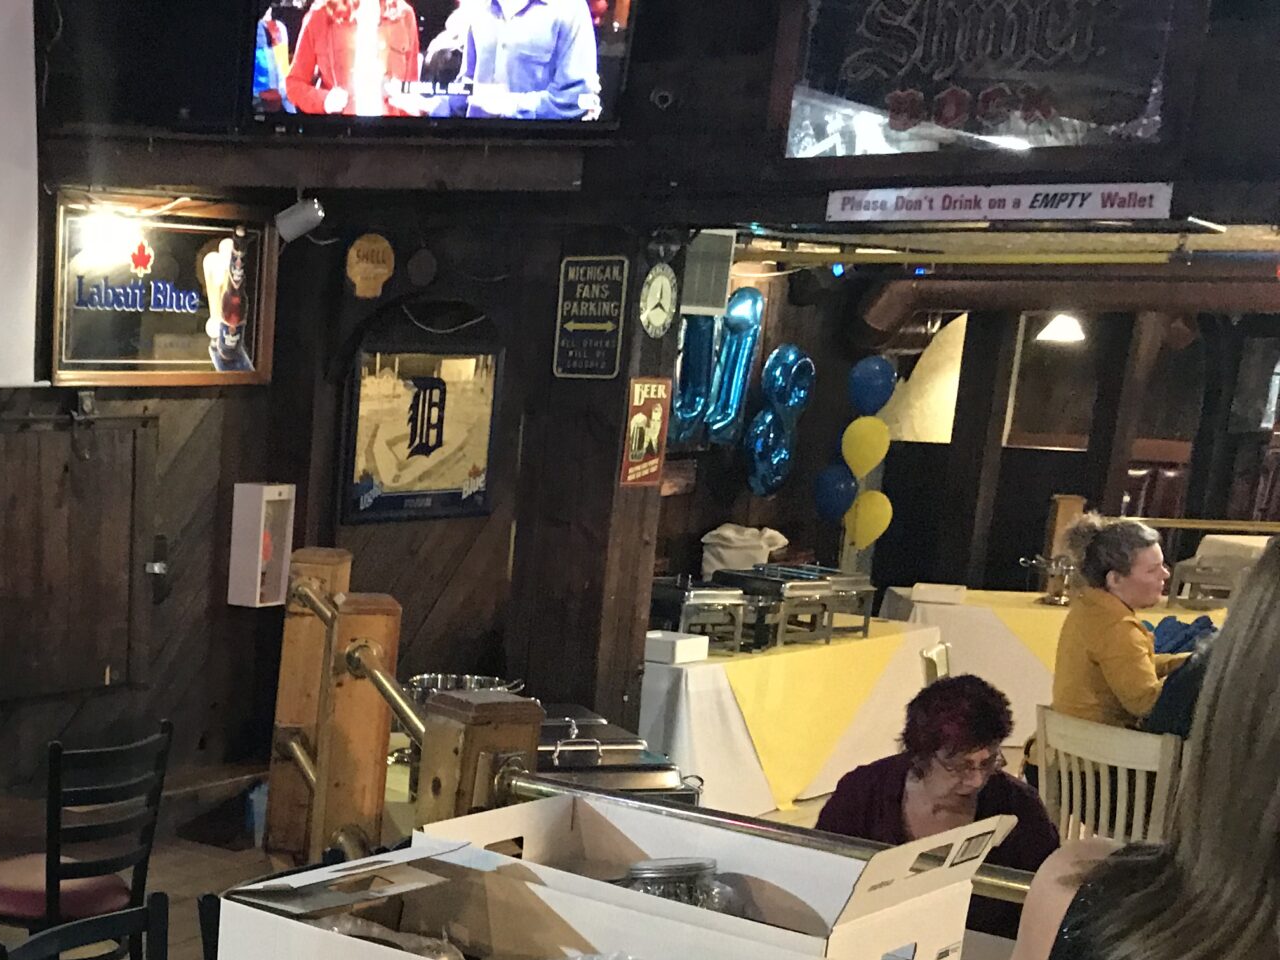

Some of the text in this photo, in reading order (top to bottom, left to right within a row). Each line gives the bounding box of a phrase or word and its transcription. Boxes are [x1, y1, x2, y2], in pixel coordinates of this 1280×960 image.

[840, 191, 1155, 212] Please Don't Drink on a EMPTY Wallet
[567, 265, 621, 282] MICHIGAN
[73, 275, 200, 313] Labatt Blue
[575, 283, 610, 299] FANS
[563, 301, 620, 317] PARKING
[632, 383, 668, 407] BEER
